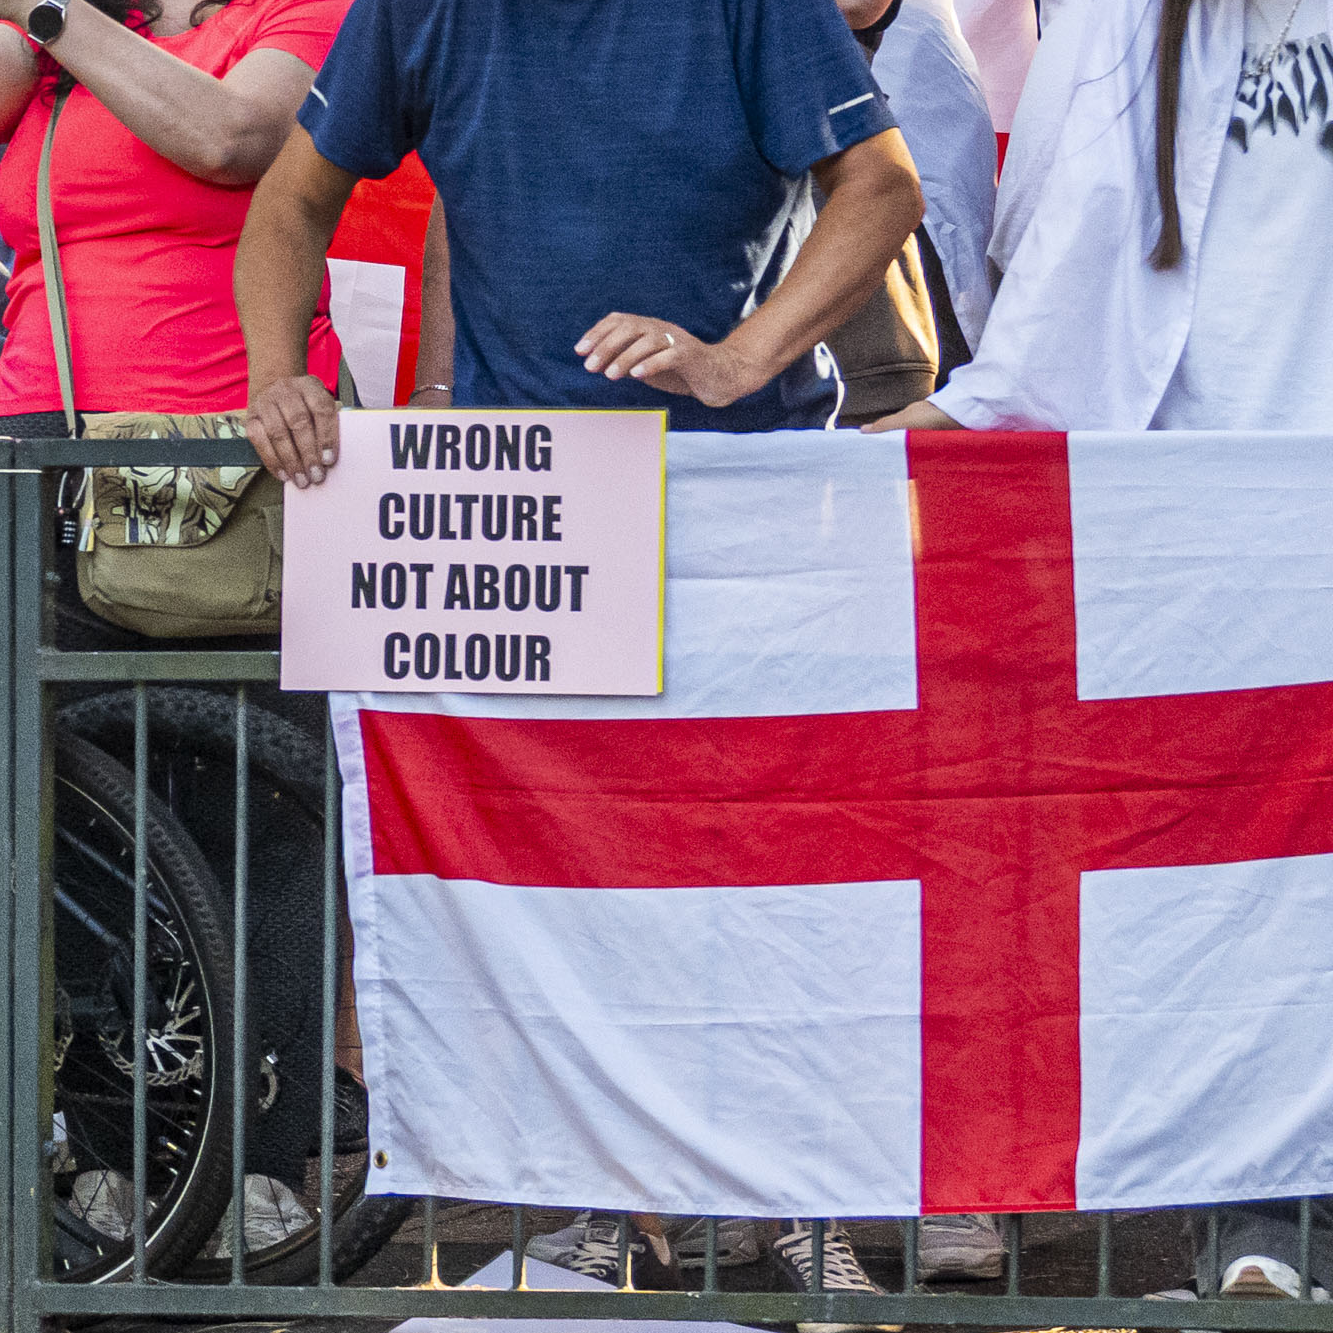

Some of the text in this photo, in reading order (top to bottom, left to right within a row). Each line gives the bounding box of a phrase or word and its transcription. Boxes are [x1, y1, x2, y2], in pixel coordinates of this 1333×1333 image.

[389, 423, 553, 472] WRONG
[378, 492, 563, 543] CULTURE
[351, 562, 590, 613] NOT ABOUT
[383, 631, 552, 682] COLOUR
